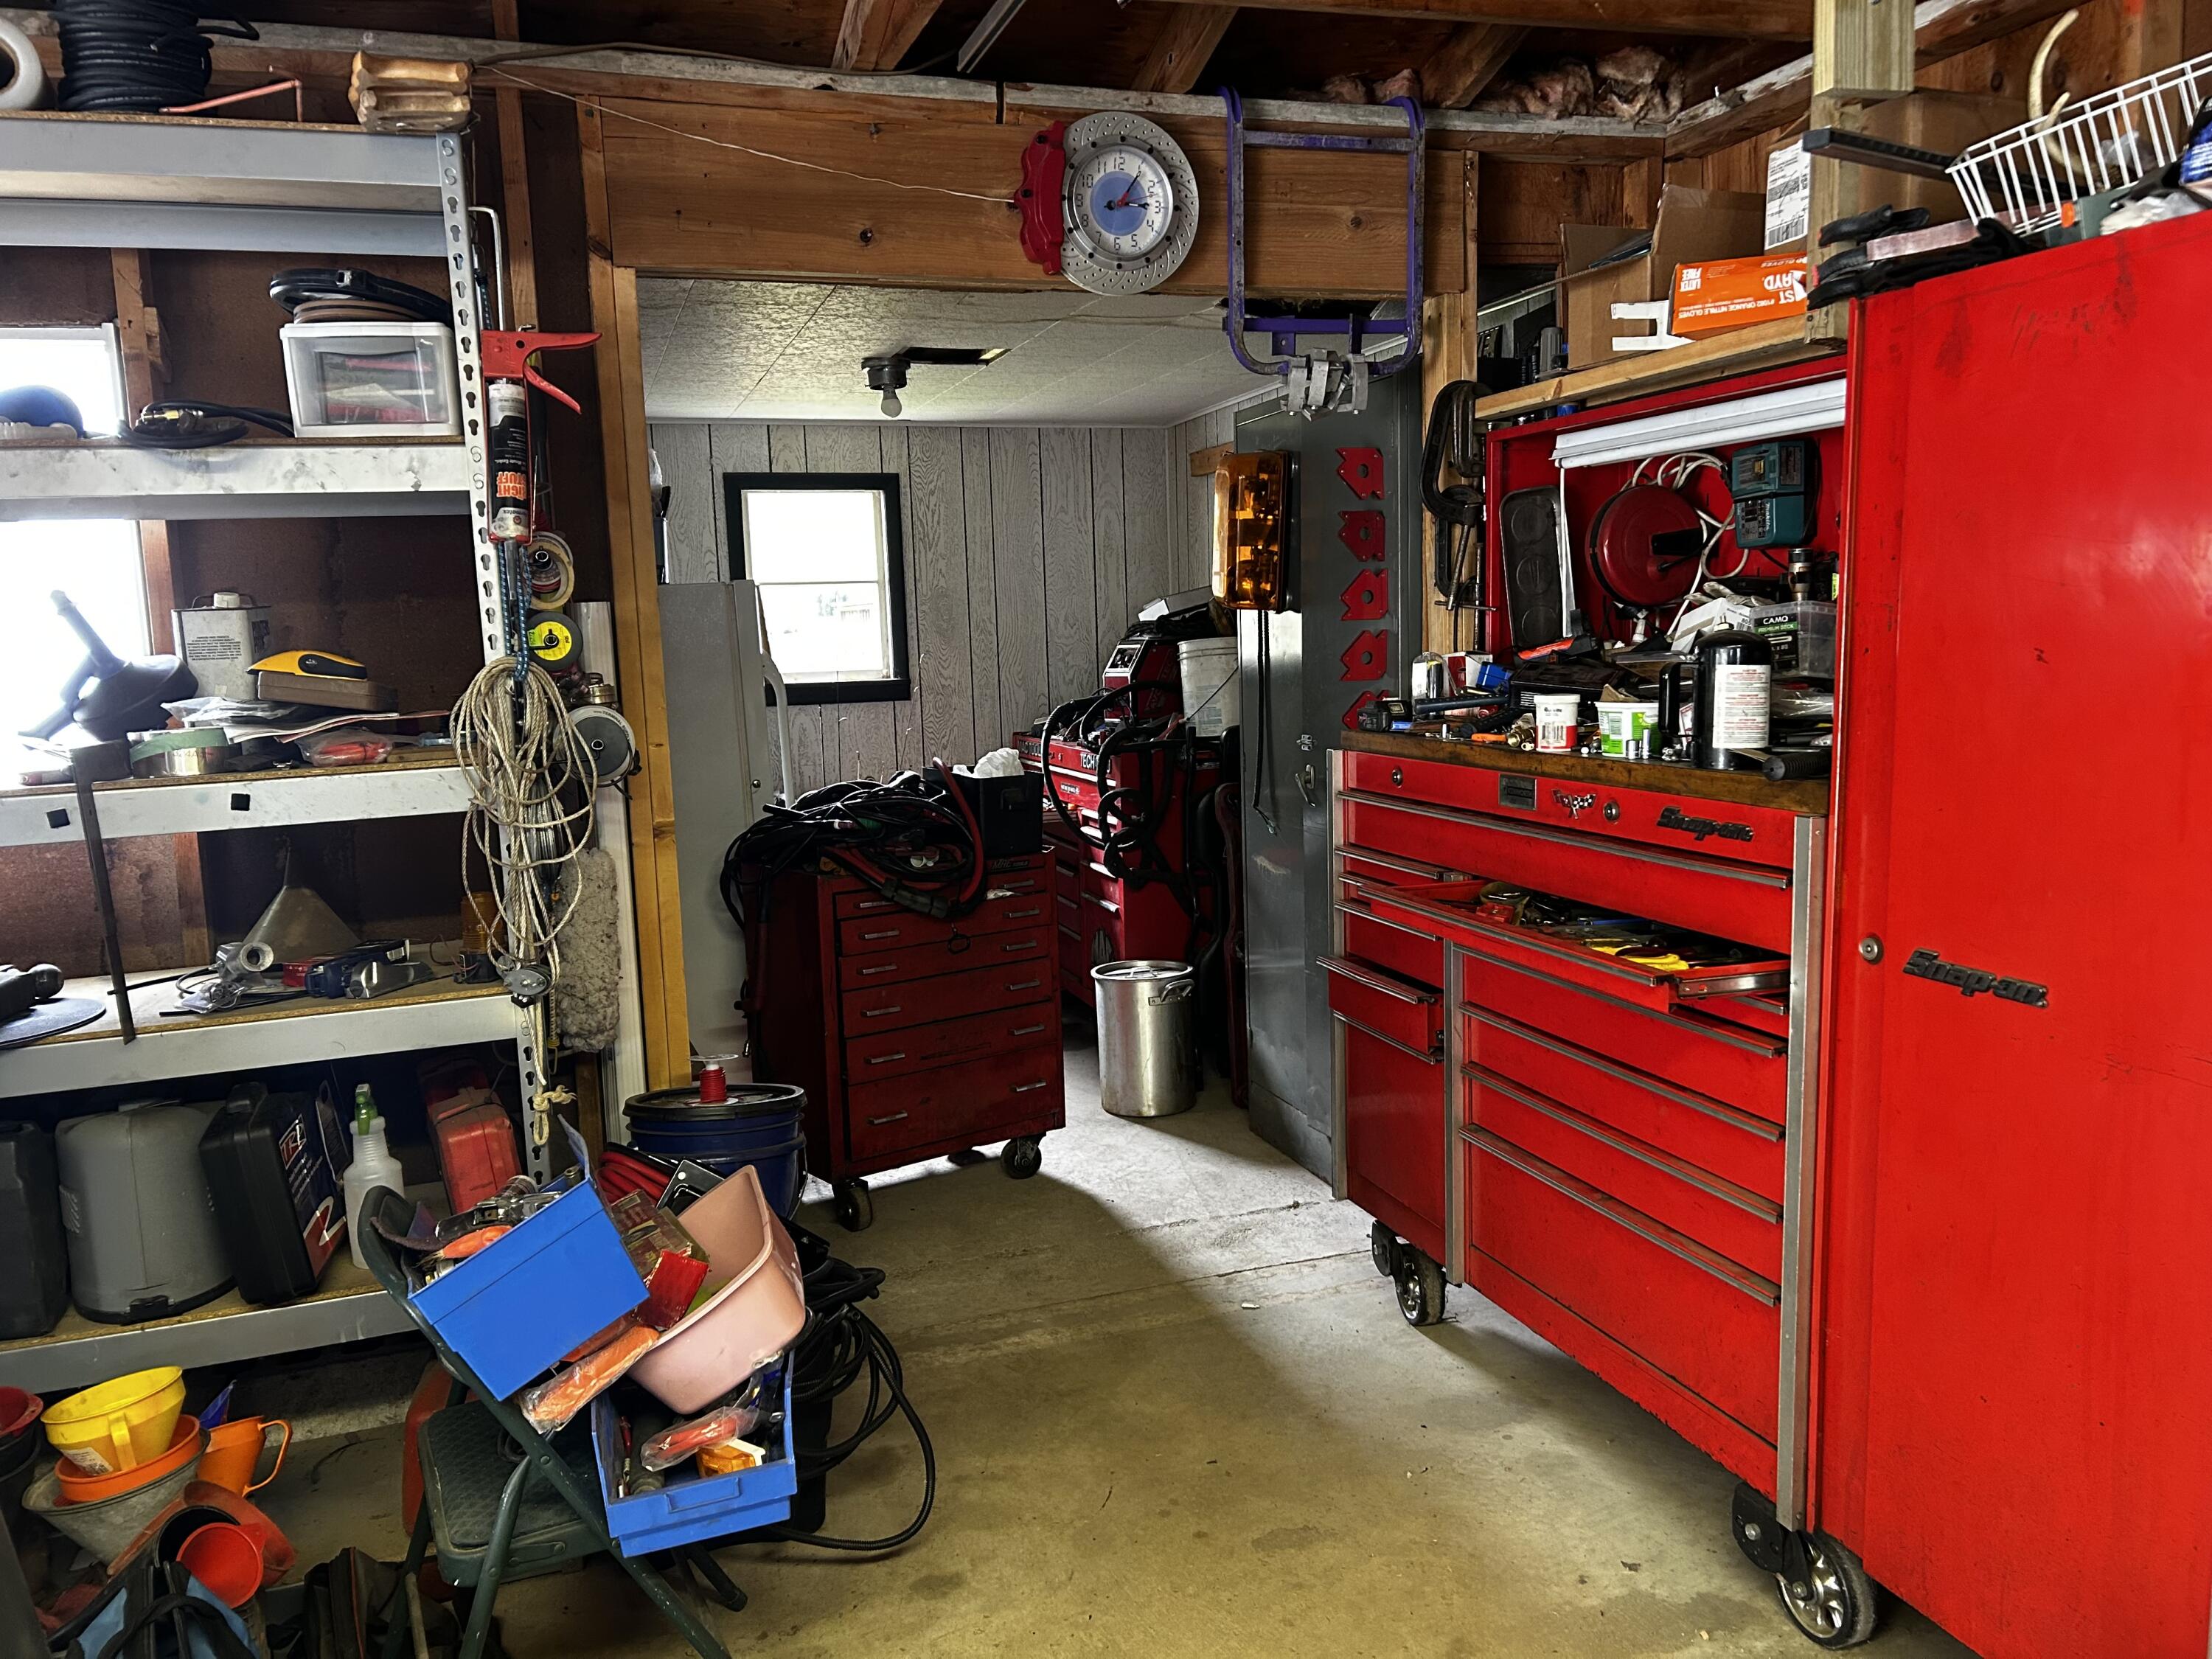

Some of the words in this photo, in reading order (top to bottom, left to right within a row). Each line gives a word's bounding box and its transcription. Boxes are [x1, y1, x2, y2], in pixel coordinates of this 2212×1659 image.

[1097, 161, 1107, 173] 11
[1113, 156, 1125, 170] 12
[1082, 174, 1093, 188] 10
[1148, 180, 1155, 195] 2
[1077, 193, 1083, 207] 9
[1155, 201, 1161, 214] 3
[1082, 214, 1089, 227] 8
[1147, 220, 1154, 232] 4
[1096, 231, 1102, 244] 7
[1114, 237, 1121, 251] 6
[1131, 234, 1138, 248] 5
[1682, 268, 1702, 280] FREE
[1763, 272, 1792, 290] AYD
[1704, 305, 1728, 315] NITRILE
[1728, 302, 1756, 311] ORANGE
[1678, 310, 1703, 319] GLOVES
[1763, 615, 1789, 625] CAMO
[1079, 753, 1095, 769] TECH
